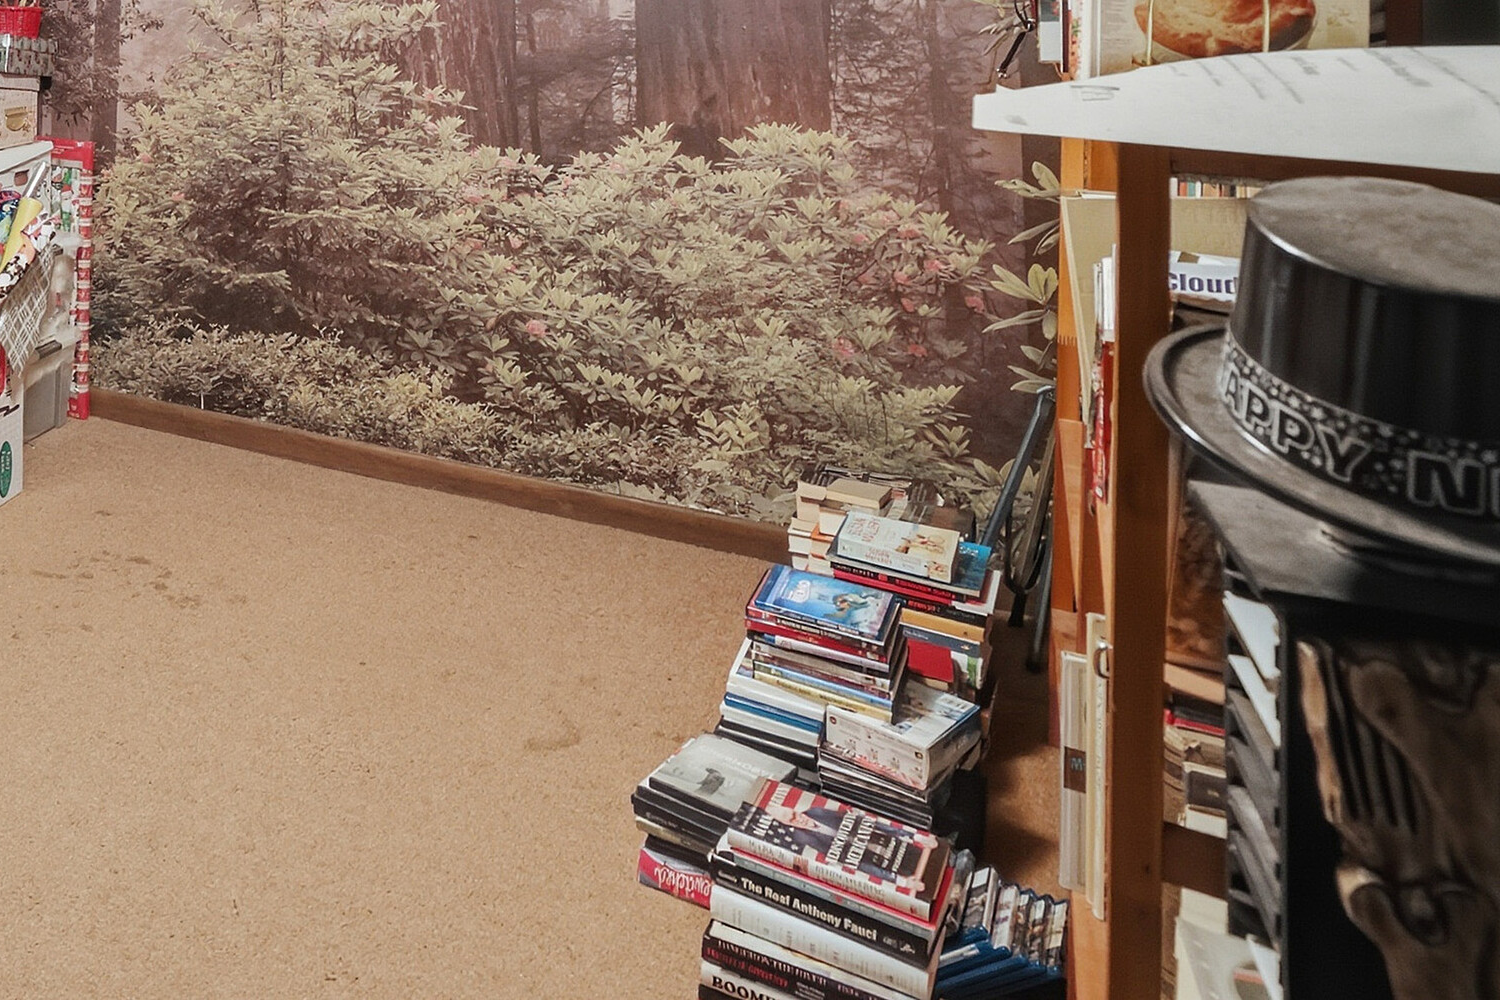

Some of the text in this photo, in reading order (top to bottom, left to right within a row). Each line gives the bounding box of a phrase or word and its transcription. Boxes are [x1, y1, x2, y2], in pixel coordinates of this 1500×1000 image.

[1220, 368, 1372, 482] APPY
[740, 877, 878, 942] The Real Anthony Fauci
